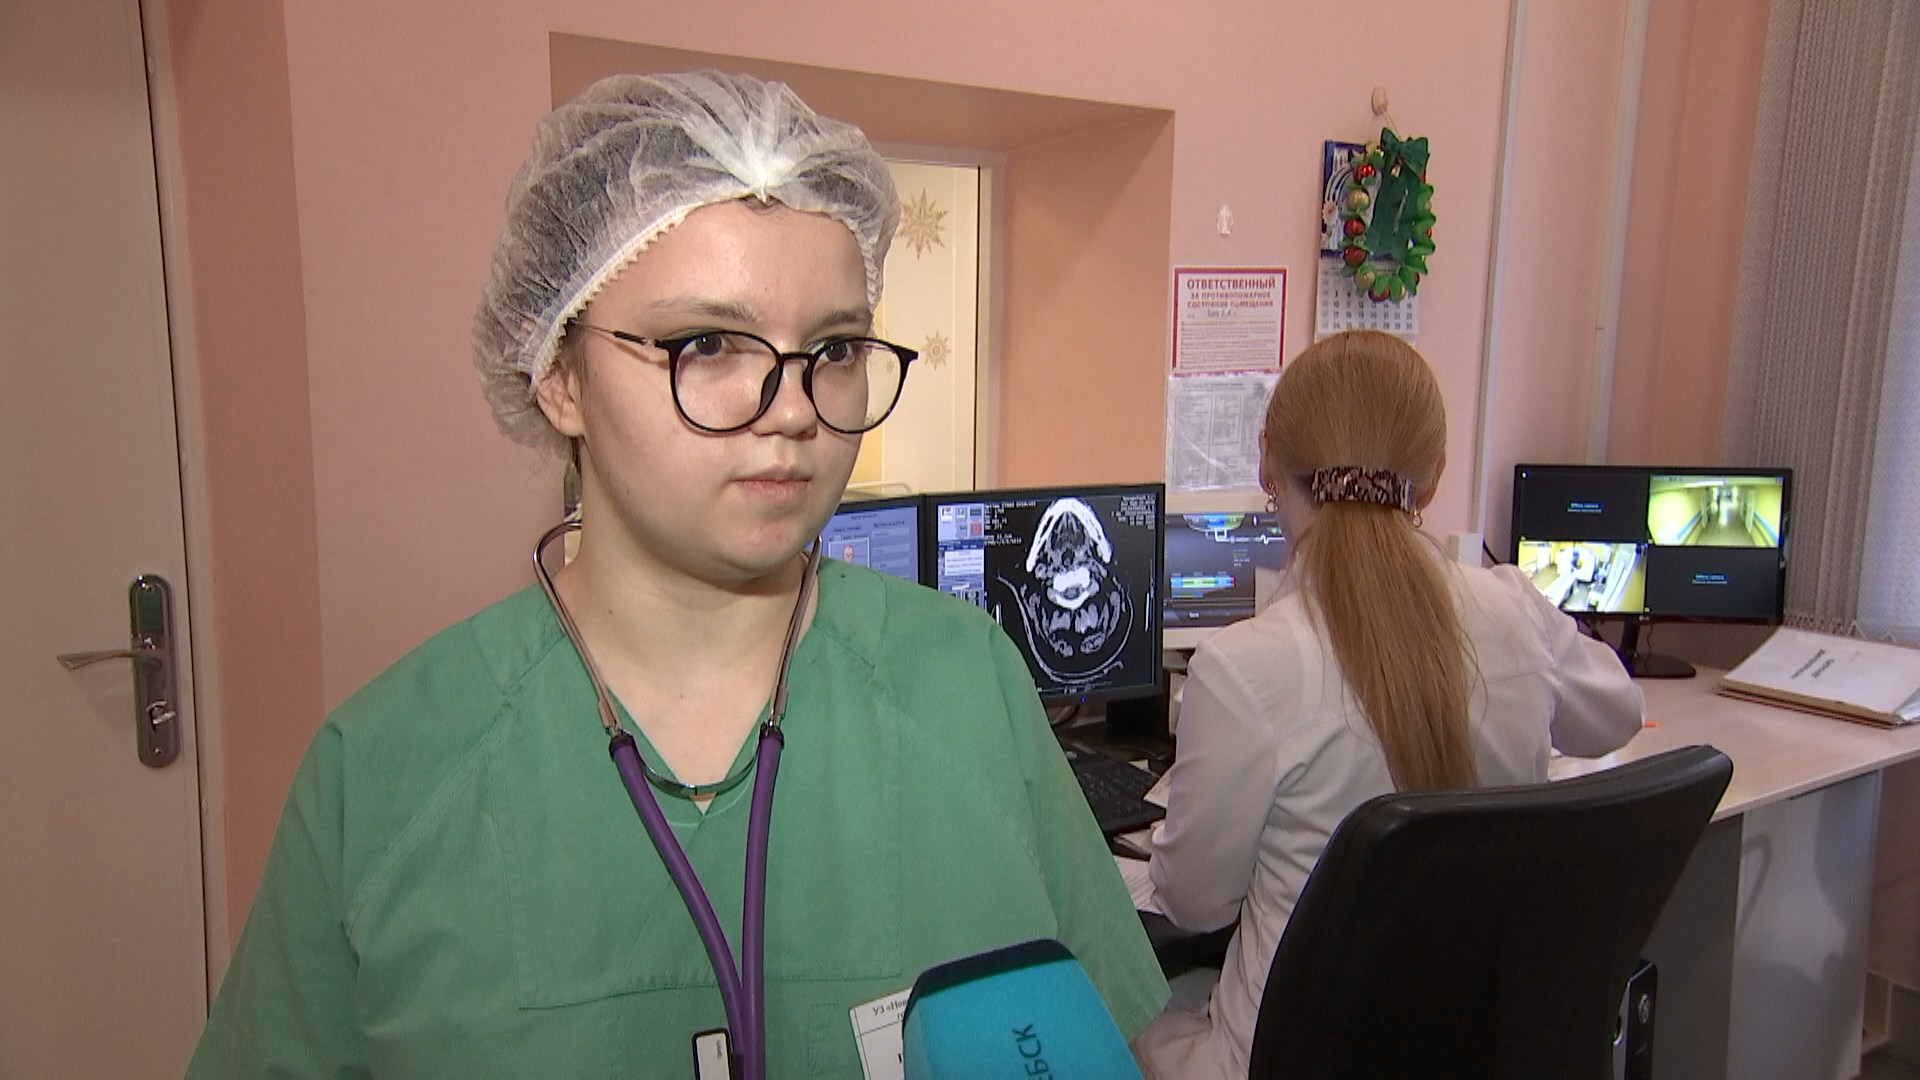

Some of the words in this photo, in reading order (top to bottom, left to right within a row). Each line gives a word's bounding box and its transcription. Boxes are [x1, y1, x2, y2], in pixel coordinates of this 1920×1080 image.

[1187, 277, 1276, 290] ОТВЕТСТВЕННЫЙ
[1191, 291, 1199, 299] ЗА
[1201, 291, 1271, 299] ПРОТИВОПОЖАРНОЕ
[1187, 300, 1228, 309] СОСТОЯНИЕ
[1230, 300, 1274, 309] ПОМЕЩЕНИЯ
